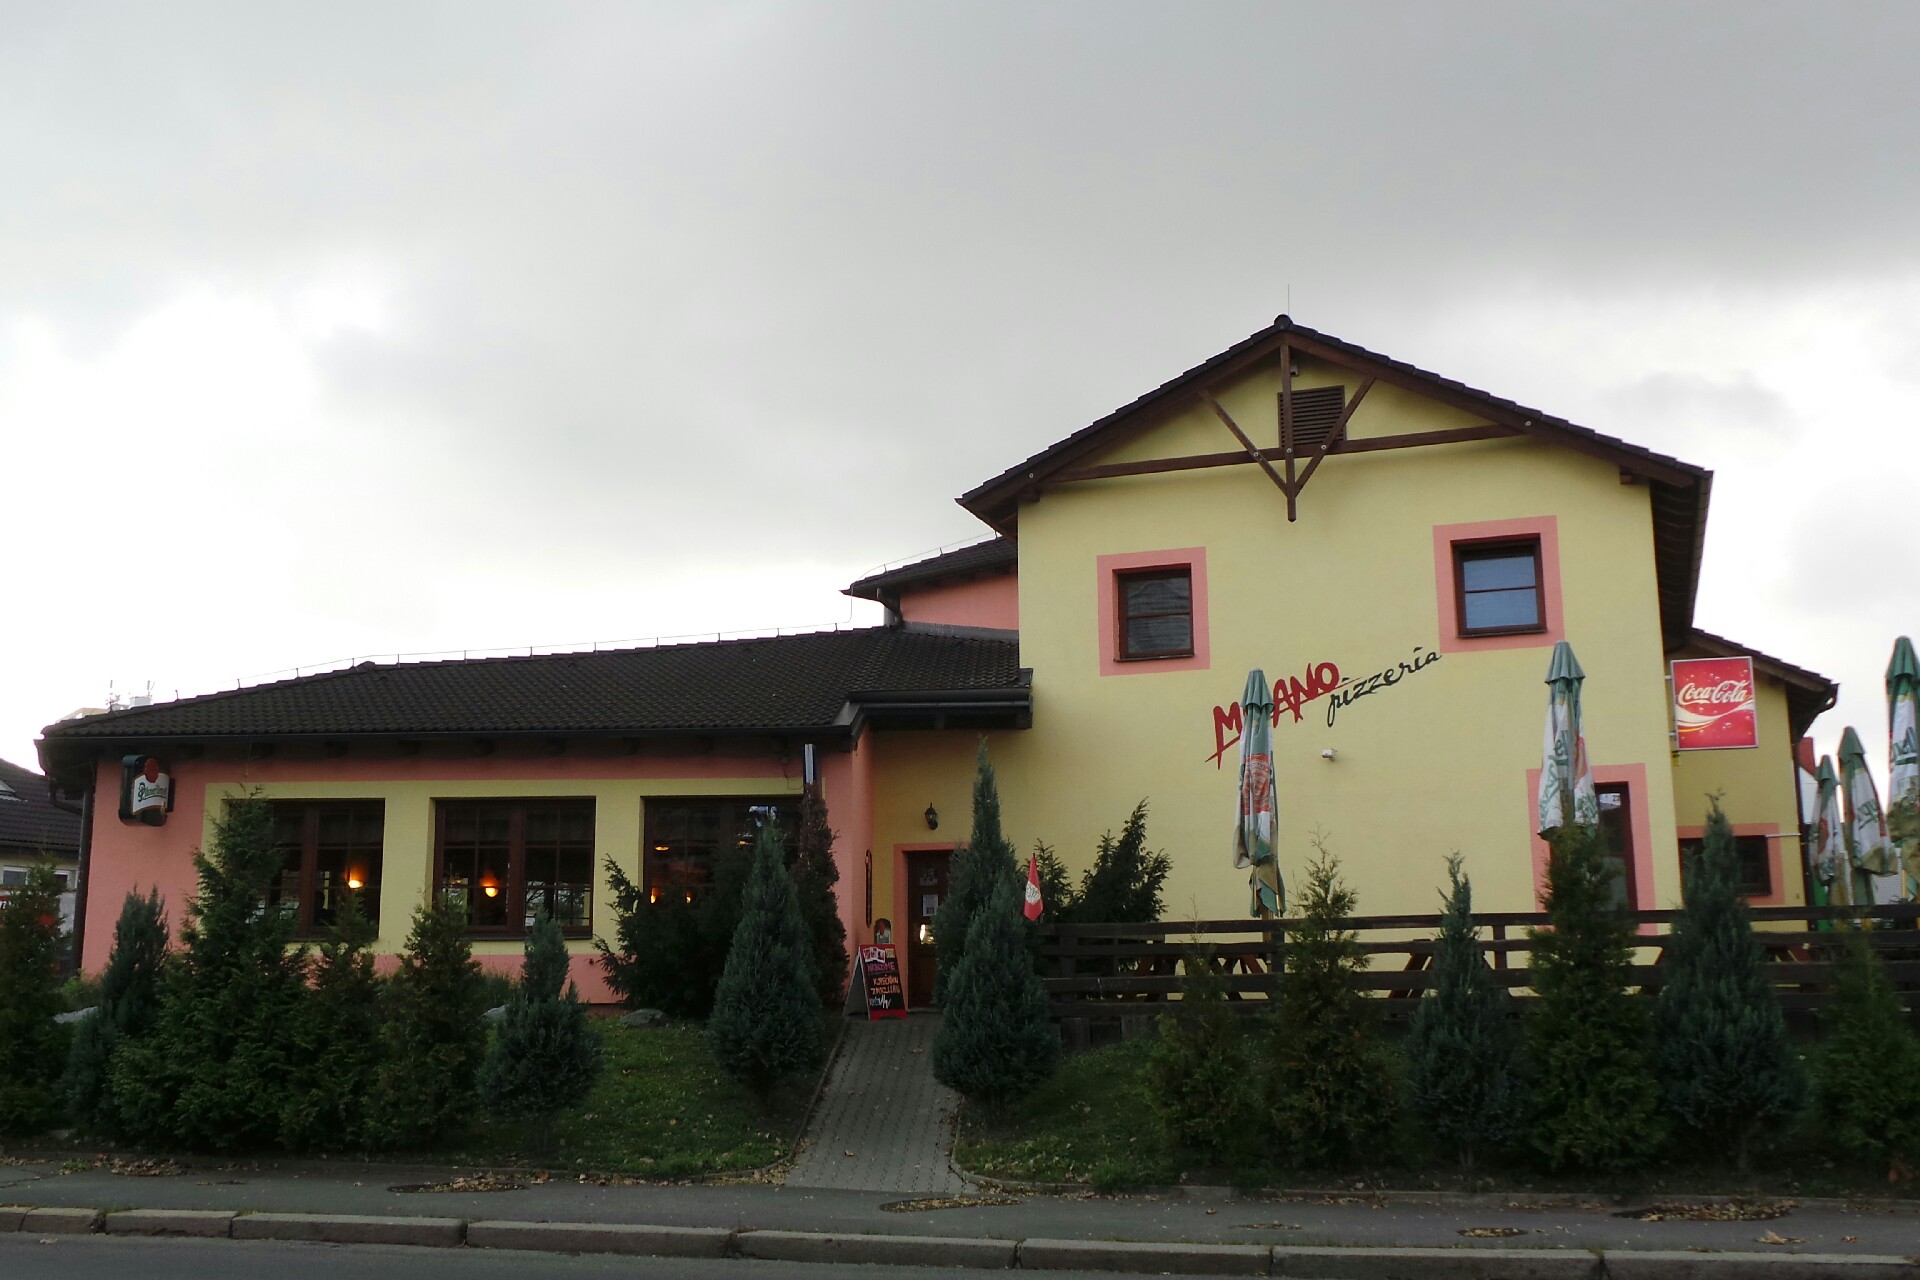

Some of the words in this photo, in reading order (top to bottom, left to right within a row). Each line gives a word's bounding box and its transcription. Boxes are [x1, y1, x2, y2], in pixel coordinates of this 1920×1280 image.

[1211, 661, 1341, 770] MANO
[1326, 646, 1442, 728] pizzeria
[1677, 680, 1750, 705] Coca-Cola
